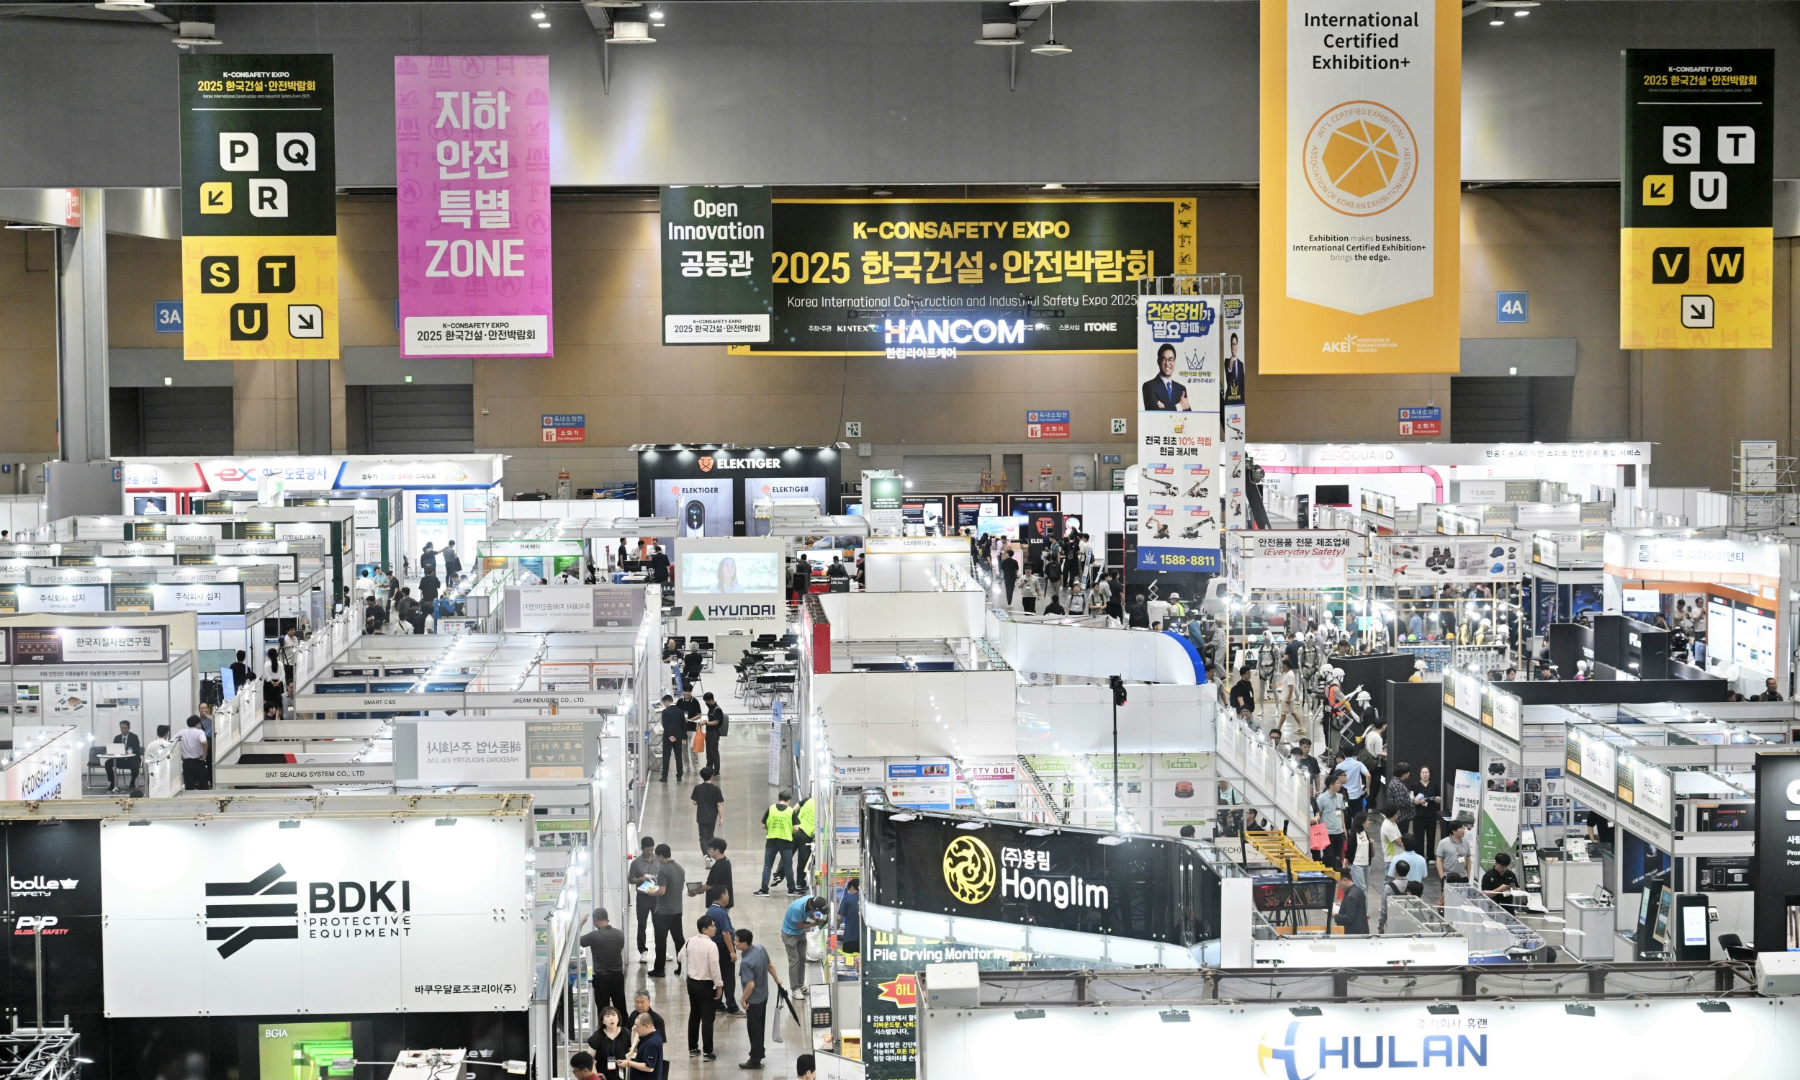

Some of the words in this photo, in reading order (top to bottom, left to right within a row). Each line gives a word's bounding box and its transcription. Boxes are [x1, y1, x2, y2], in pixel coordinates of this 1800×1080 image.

[1304, 12, 1419, 28] International
[1323, 33, 1399, 49] Certified
[1311, 54, 1411, 70] Exhibition+
[197, 80, 223, 92] 2025
[225, 80, 316, 92] 한국건설·안전박람회
[1643, 75, 1668, 86] 2025
[1670, 75, 1757, 86] 한국건설·안전박람회
[435, 91, 511, 131] 지하
[1330, 108, 1367, 124] CERTIFIED
[1367, 108, 1405, 140] EXHIBITION+
[1672, 132, 1692, 157] S
[1726, 133, 1747, 157] T
[230, 140, 249, 164] P
[283, 139, 309, 166] Q
[436, 139, 510, 181] 안전
[1310, 144, 1329, 193] ASSOCIATION
[1327, 190, 1338, 201] OF
[1336, 197, 1366, 210] KOREAN
[1366, 182, 1403, 209] EXHIBITION
[1398, 146, 1412, 184] INDUSTRY
[258, 185, 278, 210] R
[1698, 178, 1719, 203] U
[438, 189, 511, 230] 특별
[693, 199, 738, 219] Open
[668, 221, 765, 240] Innovation
[853, 221, 1008, 240] K-CONSAFETY
[1012, 220, 1071, 239] EXPO
[1308, 234, 1349, 242] Exhibition
[1350, 234, 1374, 242] makes
[1375, 234, 1412, 242] business.
[1292, 243, 1345, 252] International
[1346, 243, 1380, 252] Certified
[1382, 243, 1427, 252] Exhibition+
[425, 239, 525, 278] ZONE
[680, 250, 755, 277] 공동관
[1330, 253, 1353, 262] brings
[1354, 253, 1368, 262] the
[1369, 253, 1391, 262] edge.
[1659, 253, 1684, 277] V
[1710, 253, 1742, 277] W
[771, 251, 850, 285] 2025
[860, 249, 1155, 285] 한국건설·안전박람회
[209, 262, 231, 288] S
[265, 262, 287, 287] T
[787, 296, 818, 308] Korea
[821, 295, 891, 308] International
[966, 295, 986, 308] and
[1043, 295, 1079, 309] Safety
[1082, 295, 1108, 308] Expo
[1111, 294, 1137, 307] 2025
[1501, 300, 1524, 315] 4A
[159, 309, 182, 324] 3A
[1147, 303, 1212, 321] 건설장비가
[237, 309, 260, 335] U
[674, 325, 693, 333] 2025
[1084, 322, 1118, 332] ITONE
[417, 330, 442, 341] 2025
[445, 329, 536, 341] 한국건설·안전박람회
[885, 319, 1025, 344] HANCOM
[885, 346, 957, 359] 한컴라이프케어
[1145, 435, 1161, 446] 전국
[1162, 435, 1178, 446] 최초
[1178, 437, 1196, 446] 10%
[1321, 450, 1394, 460] ZEROGUARD
[716, 457, 781, 470] ELEKTIGER
[1258, 538, 1293, 547] 안전용품
[1296, 538, 1313, 547] 전문
[1315, 538, 1350, 547] 제조업체
[1160, 554, 1215, 566] 1588-8811
[1263, 548, 1309, 558] (Everyday
[1311, 548, 1346, 556] Safety)
[708, 604, 776, 616] HYUNDAI
[76, 636, 151, 648] 한국지질자원연구원
[1000, 846, 1050, 872] (주)홍림
[10, 875, 60, 890] bolle
[1001, 867, 1109, 910] Honglim
[309, 880, 411, 914] BDKI
[309, 915, 411, 927] PROTECTIVE
[309, 928, 411, 939] EQUIPMENT
[873, 948, 897, 962] Pile
[944, 947, 1014, 962] Monitoring
[414, 983, 517, 996] 바쿠우달로즈코리아(주)
[1417, 1018, 1461, 1029] 주식회사
[1466, 1018, 1488, 1029] 휴랜
[265, 1029, 288, 1038] BGIA
[1319, 1034, 1488, 1069] HULAN
